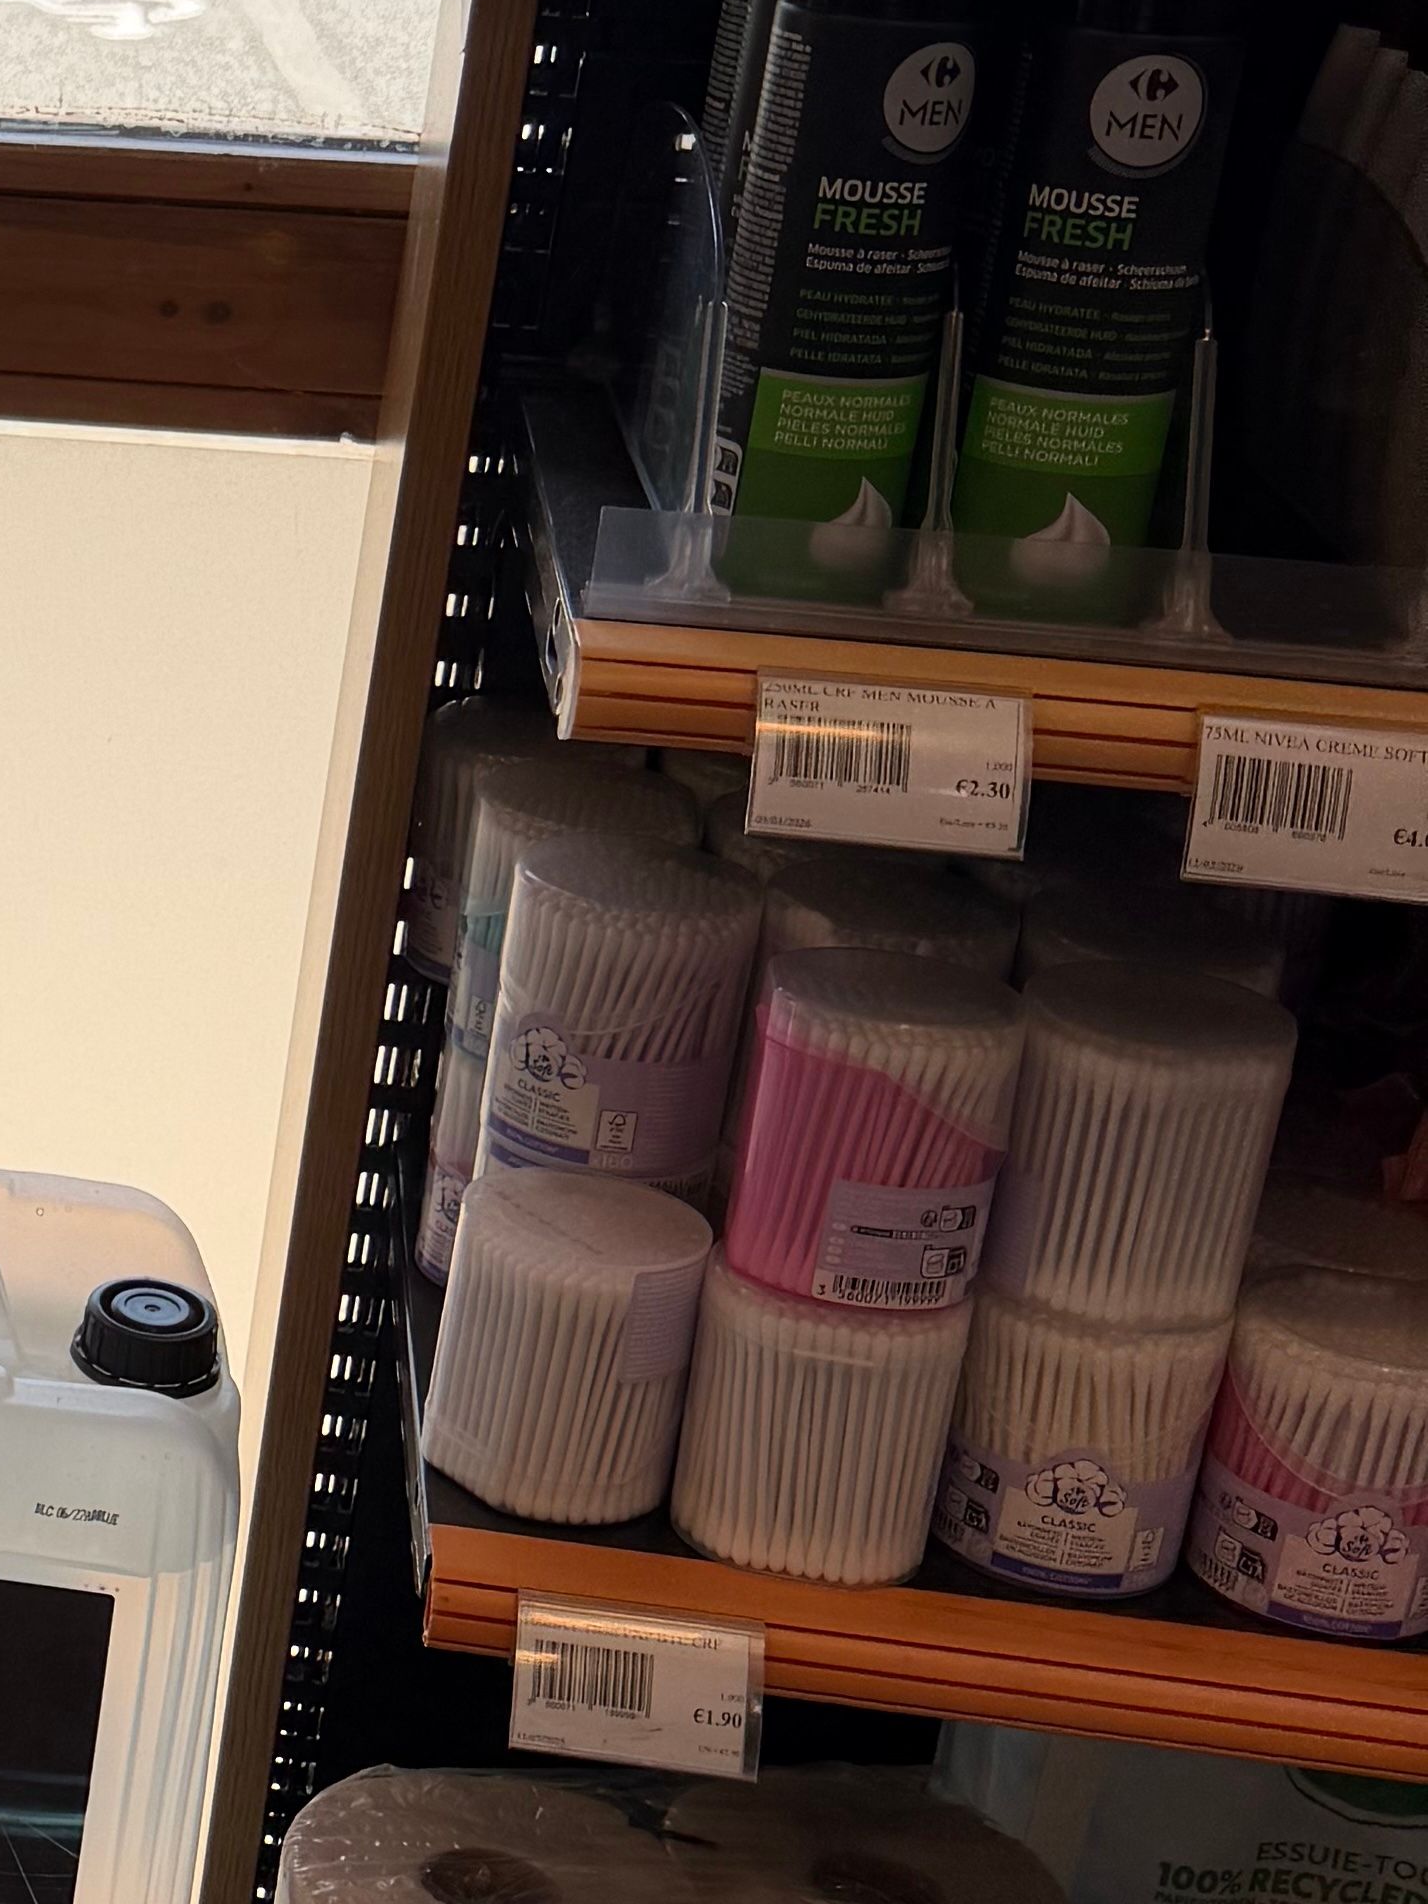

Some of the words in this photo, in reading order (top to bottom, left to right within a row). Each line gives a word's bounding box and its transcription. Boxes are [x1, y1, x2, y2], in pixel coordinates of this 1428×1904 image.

[899, 98, 962, 127] MEN
[1105, 110, 1183, 142] MEN
[818, 175, 929, 206] MOUSSE
[1027, 182, 1141, 220] MOUSSE
[811, 201, 923, 238] FRESH
[1023, 210, 1134, 253] FRESH
[805, 255, 855, 273] Espuma
[807, 242, 855, 258] Mousse
[867, 248, 898, 262] raser
[1017, 249, 1061, 270] Mousse
[1072, 261, 1105, 275] raser
[1013, 263, 1058, 285] Espuma
[781, 388, 836, 408] PEAUX
[779, 403, 859, 422] NORMALE
[989, 396, 1040, 419] PEAUX
[1041, 407, 1130, 427] NORMALES
[777, 416, 831, 436] PIELES
[987, 410, 1061, 437] NORMALE
[1064, 424, 1106, 440] HUID
[984, 424, 1032, 446] PIELES
[1036, 435, 1125, 455] NORMALES
[1022, 447, 1100, 467] NORMALI
[763, 696, 821, 713] RASER
[861, 687, 903, 704] MEN
[906, 692, 983, 709] MOUSSE
[1204, 725, 1249, 745] 75ML
[1254, 730, 1310, 752] NIVEA
[1315, 738, 1380, 759] CREME
[1383, 746, 1428, 766] SOFT
[954, 778, 1012, 801] €2.30
[1041, 1515, 1097, 1533] CLASSIC
[693, 1707, 743, 1729] €1.90
[1158, 1860, 1244, 1895] 100%
